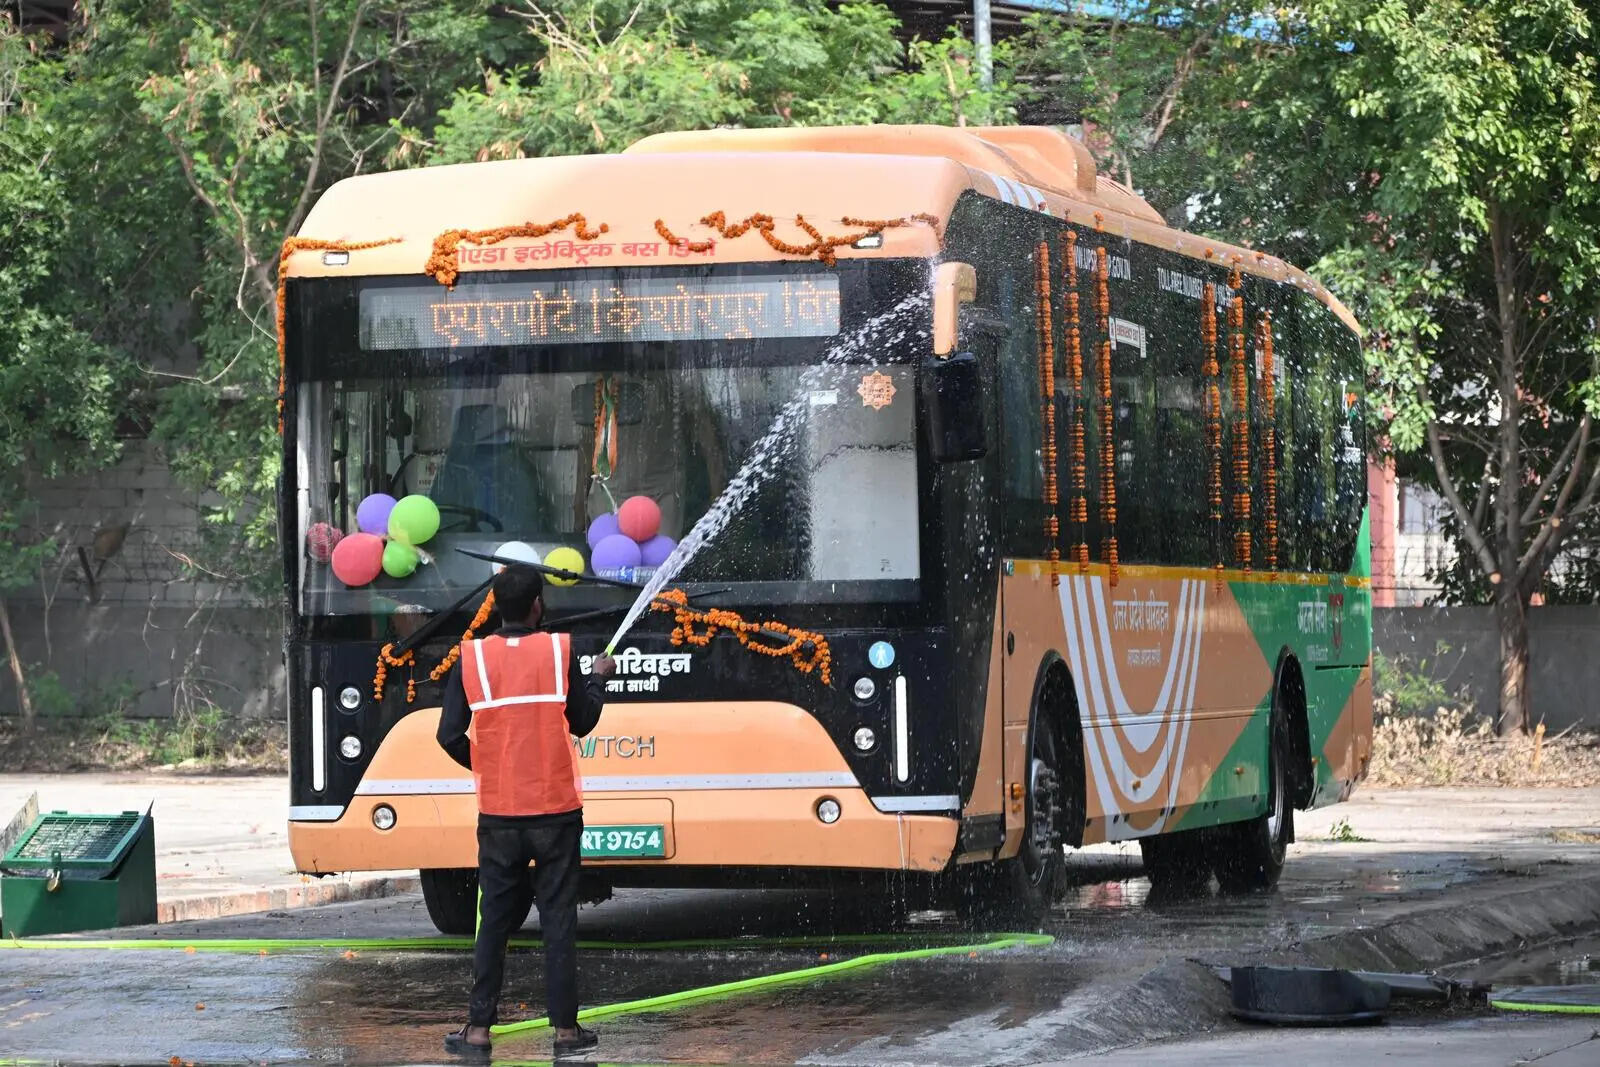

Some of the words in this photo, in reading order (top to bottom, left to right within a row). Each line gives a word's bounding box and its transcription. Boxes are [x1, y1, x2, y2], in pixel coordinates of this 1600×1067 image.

[456, 245, 508, 264] ोएडा
[513, 240, 616, 265] इलेक्ट्रिक
[621, 242, 662, 257] बस
[667, 237, 719, 258] डिो
[626, 675, 660, 692] साथी
